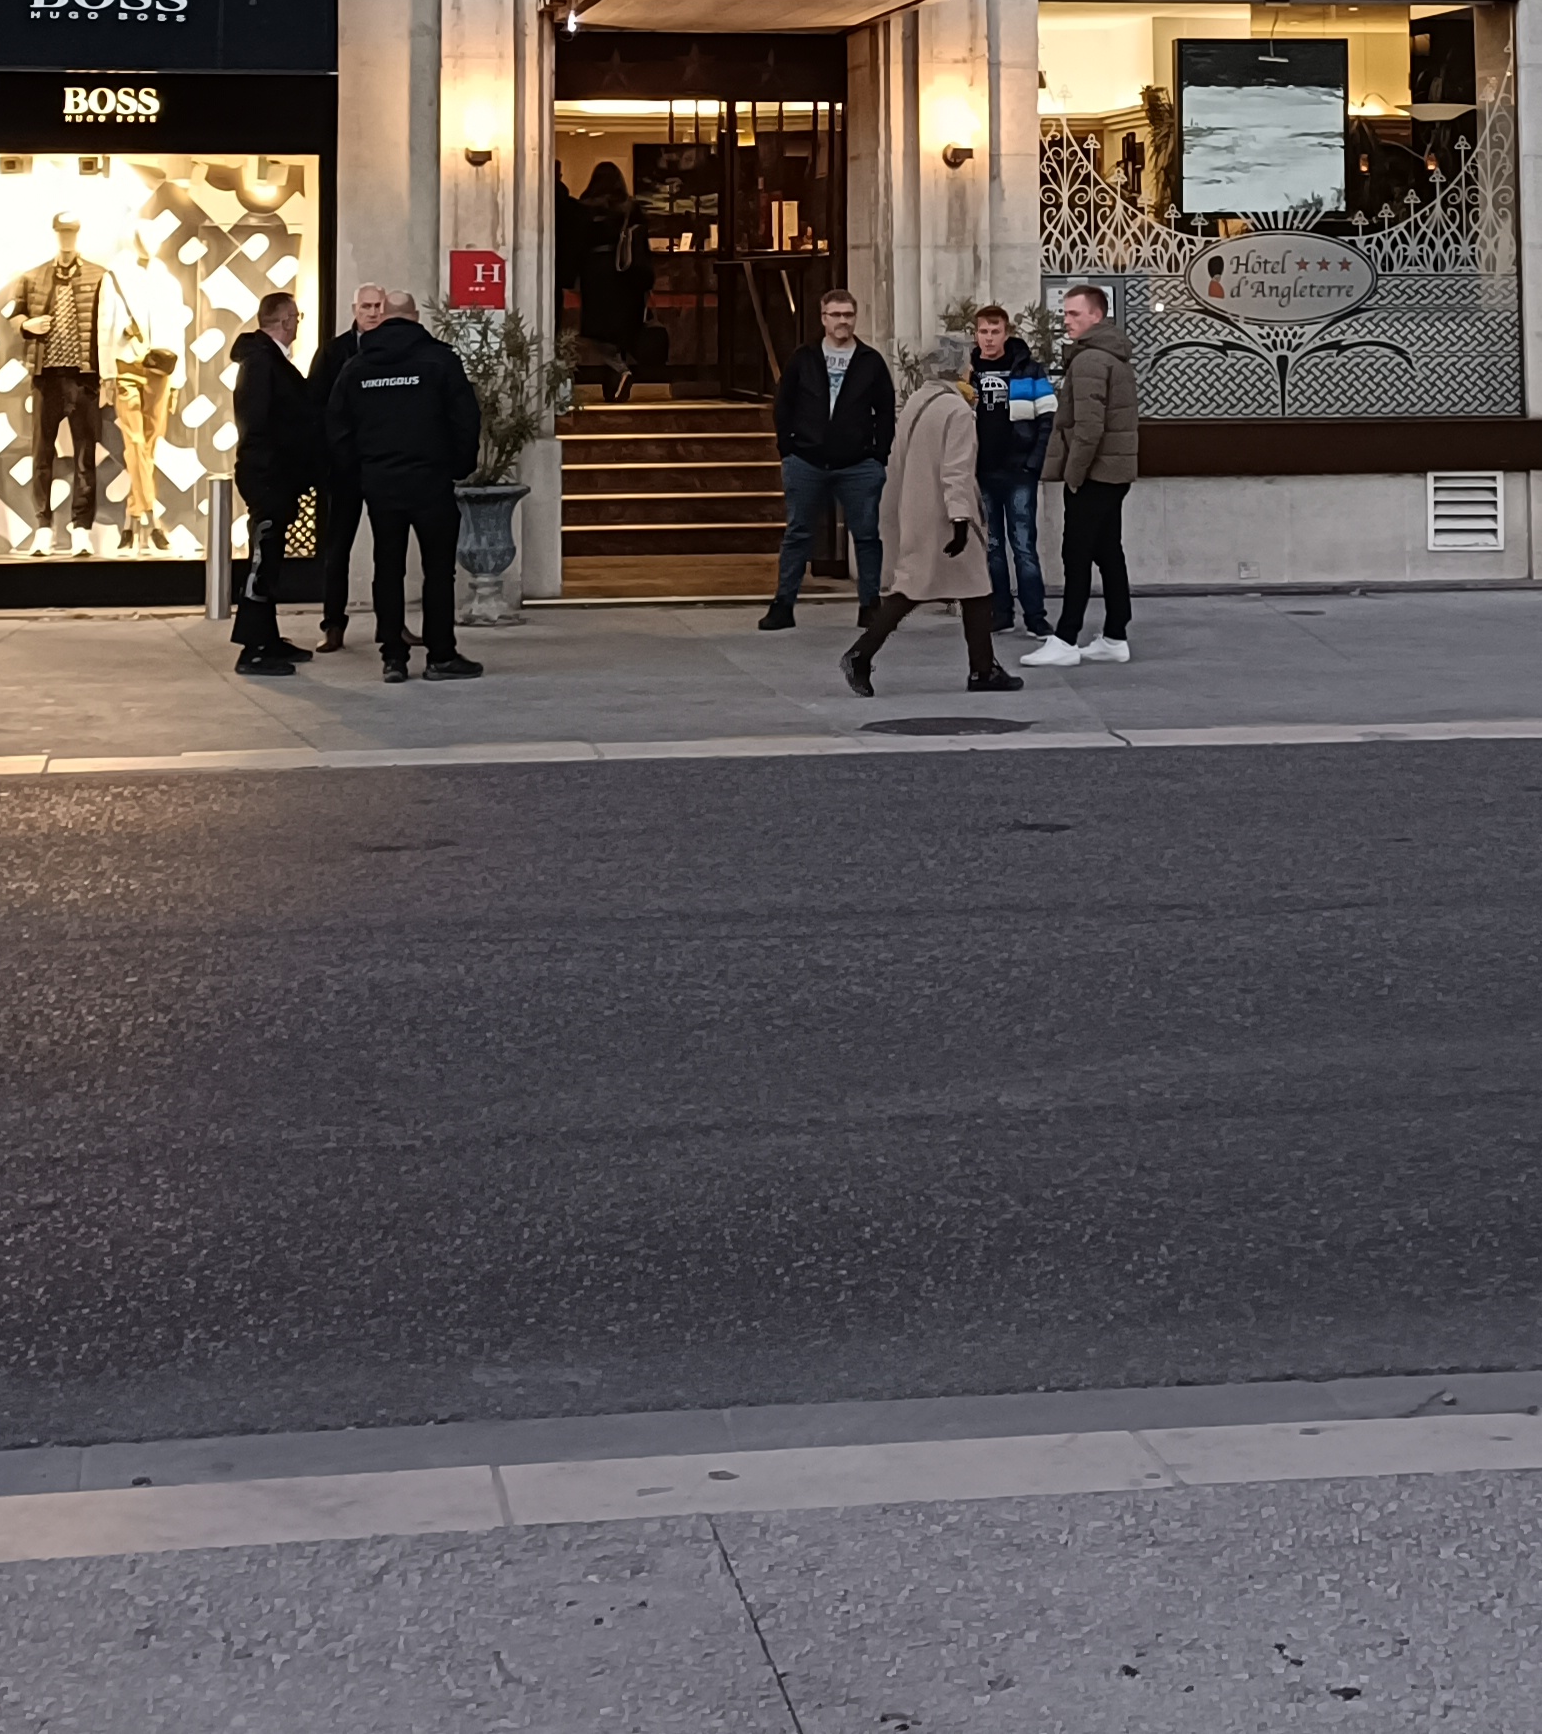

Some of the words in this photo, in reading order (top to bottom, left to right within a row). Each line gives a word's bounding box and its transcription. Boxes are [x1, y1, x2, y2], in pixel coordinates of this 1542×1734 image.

[30, 11, 99, 20] HUGO
[117, 12, 187, 23] BOSS
[62, 86, 161, 115] BOSS
[473, 263, 502, 283] H
[1230, 249, 1292, 275] Hôtel
[1230, 276, 1355, 308] d'Angleterre
